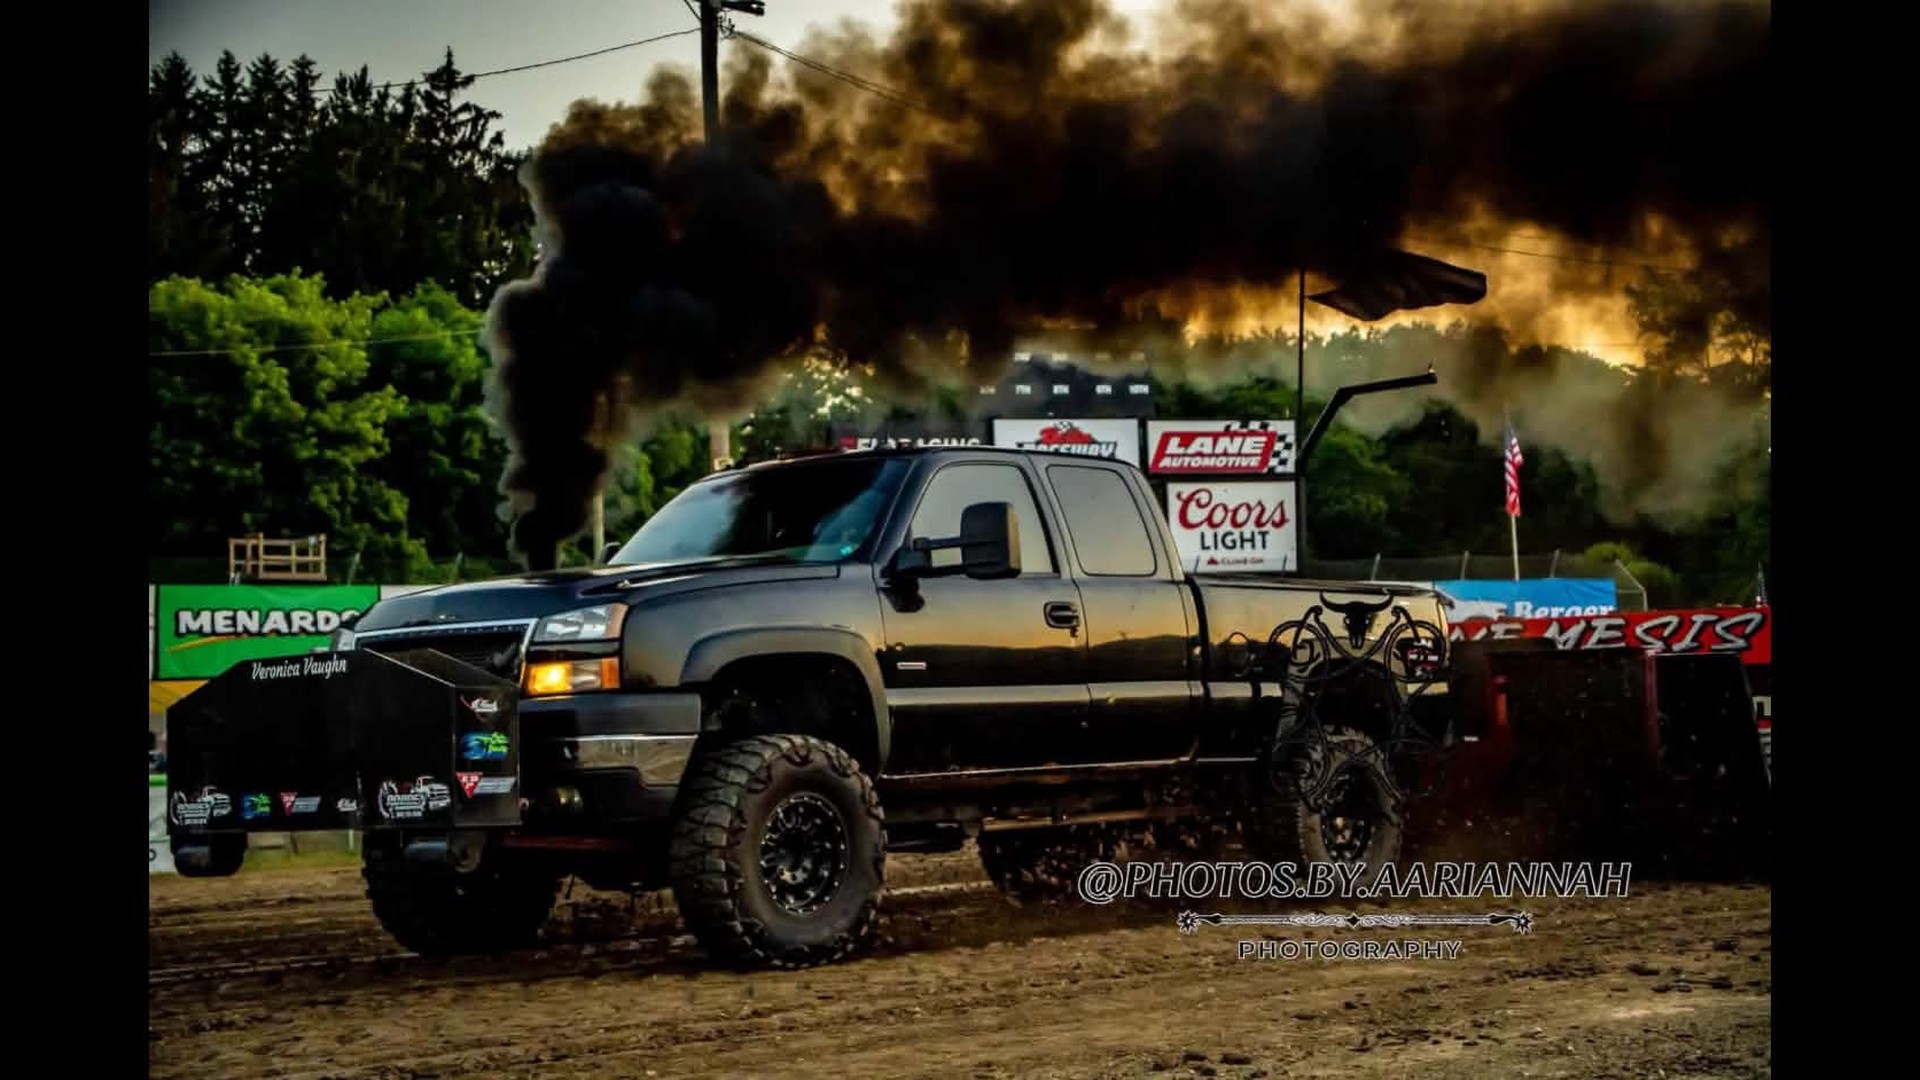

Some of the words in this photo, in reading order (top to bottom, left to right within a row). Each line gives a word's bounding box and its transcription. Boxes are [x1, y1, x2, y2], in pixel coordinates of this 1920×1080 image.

[1165, 436, 1268, 454] LANE
[1158, 456, 1261, 468] AUTOMOTIVE
[1176, 487, 1290, 530] Coors
[1200, 531, 1270, 551] LIGHT
[252, 660, 300, 680] Veronica
[303, 654, 347, 679] Vaughn
